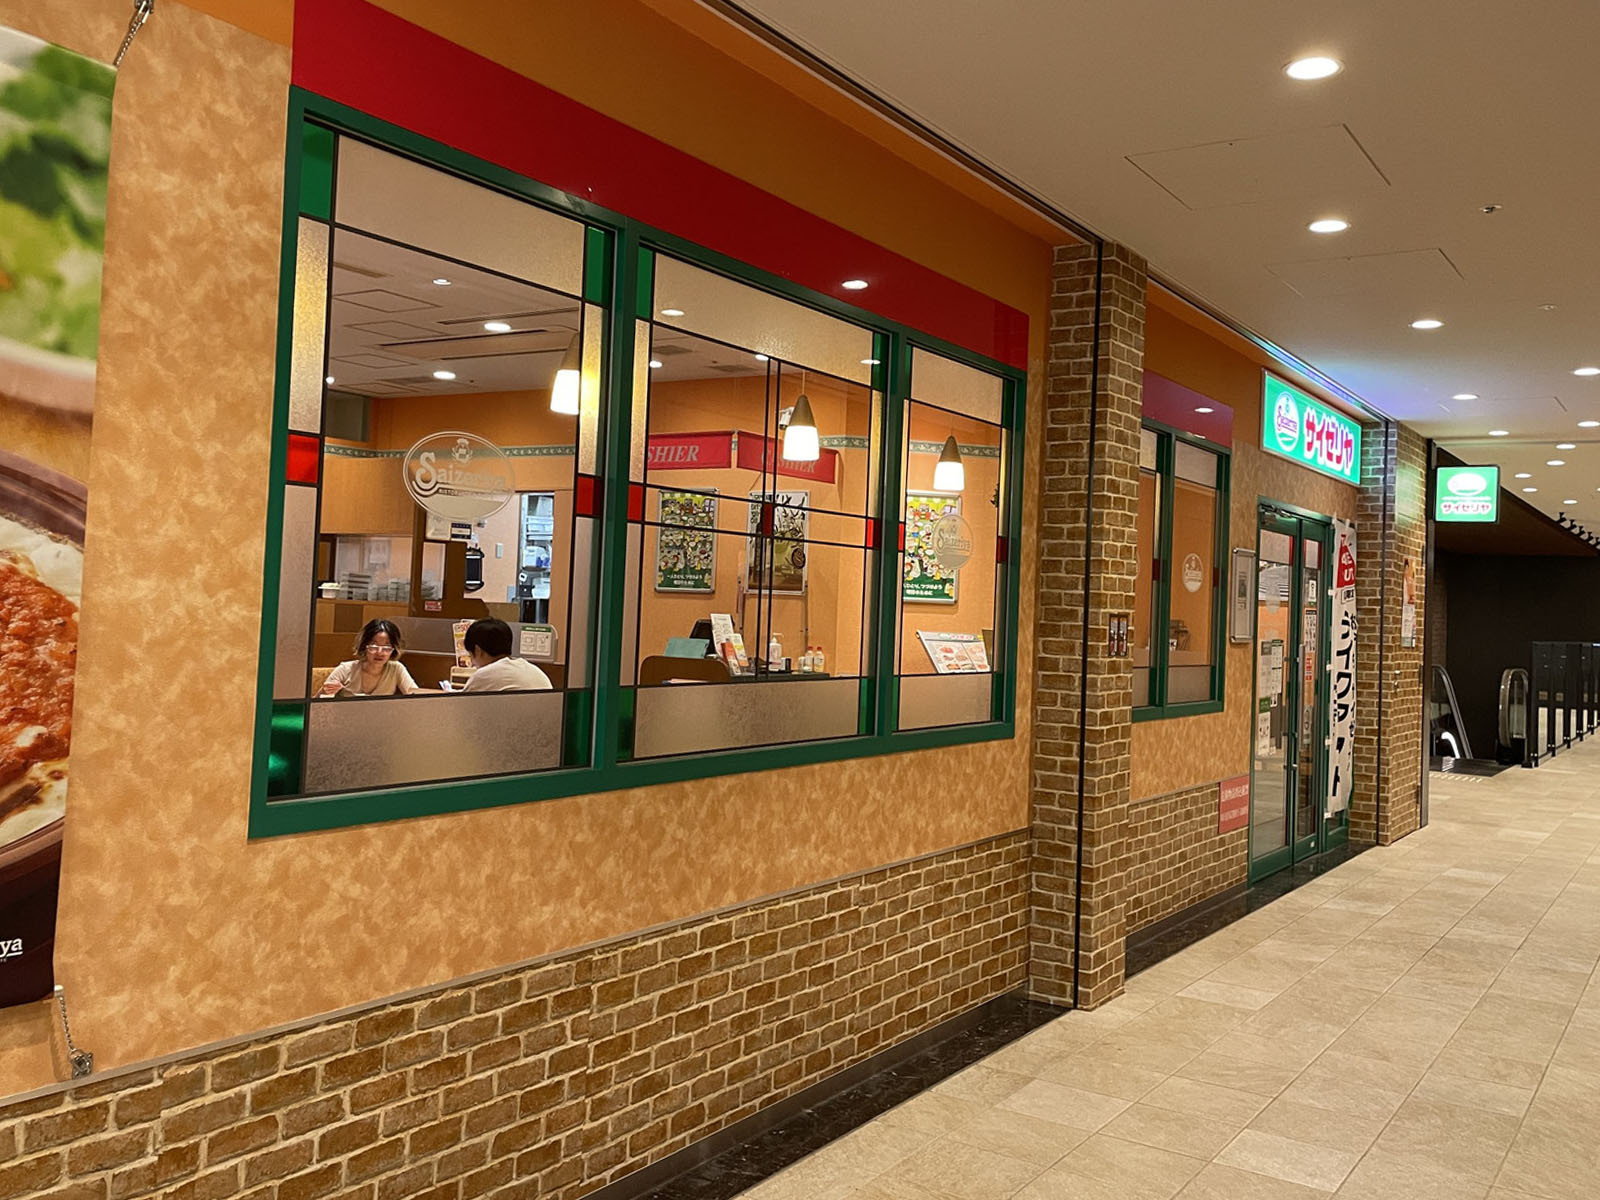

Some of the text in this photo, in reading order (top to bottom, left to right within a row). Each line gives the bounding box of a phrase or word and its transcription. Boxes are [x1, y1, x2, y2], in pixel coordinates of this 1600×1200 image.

[1305, 410, 1353, 472] サイゼリヤ
[415, 451, 506, 489] Saizeya
